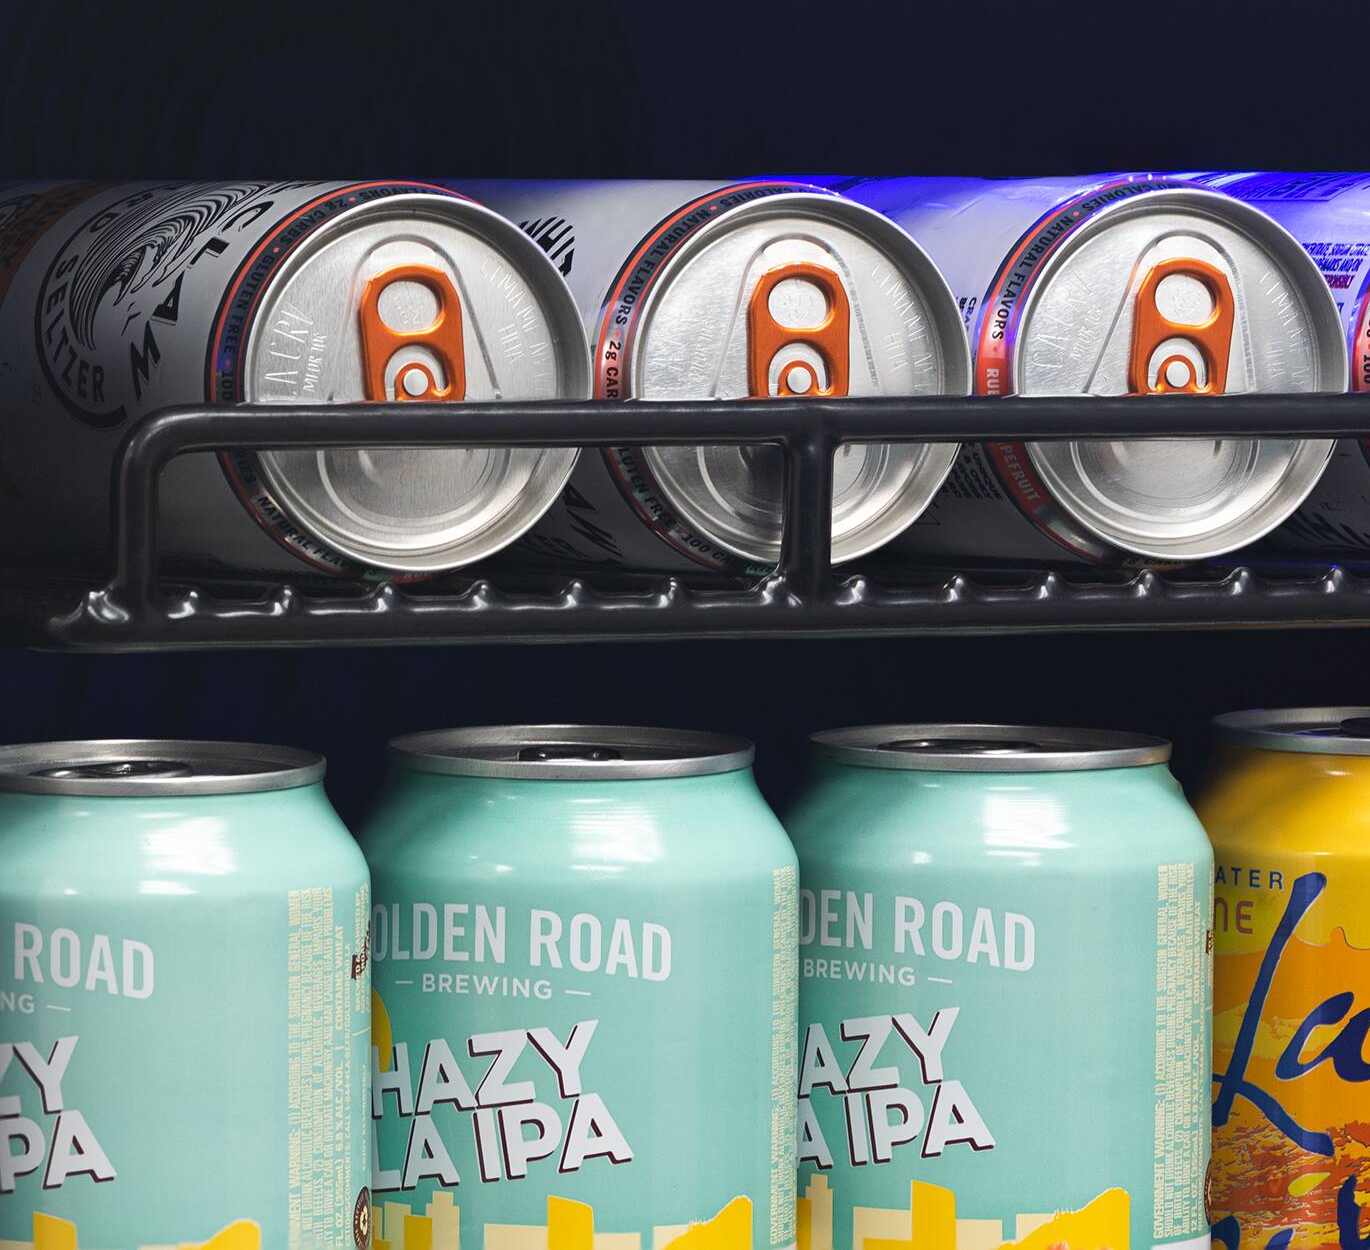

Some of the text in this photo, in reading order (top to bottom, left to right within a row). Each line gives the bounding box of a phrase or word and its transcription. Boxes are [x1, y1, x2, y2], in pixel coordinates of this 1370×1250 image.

[281, 208, 326, 256] CARBS
[614, 209, 713, 326] NATURAL FLAVORS
[225, 252, 275, 354] GLUTEN FREE
[991, 215, 1076, 341] NATURAL FLAVORS
[46, 254, 106, 404] SELTZER
[604, 340, 622, 361] 2g
[220, 368, 234, 401] 100
[257, 495, 310, 551] NATURAL
[1215, 865, 1285, 892] ATER
[14, 921, 155, 1000] ROAD
[371, 902, 506, 964] OLDEN
[530, 908, 673, 983] ROAD
[894, 892, 1037, 973] ROAD
[421, 972, 554, 1001] BREWING
[803, 959, 917, 988] BREWING
[371, 1018, 600, 1118] HAZY
[798, 1005, 961, 1101] AZY
[471, 1090, 635, 1183] IPA
[843, 1078, 997, 1168] IPA
